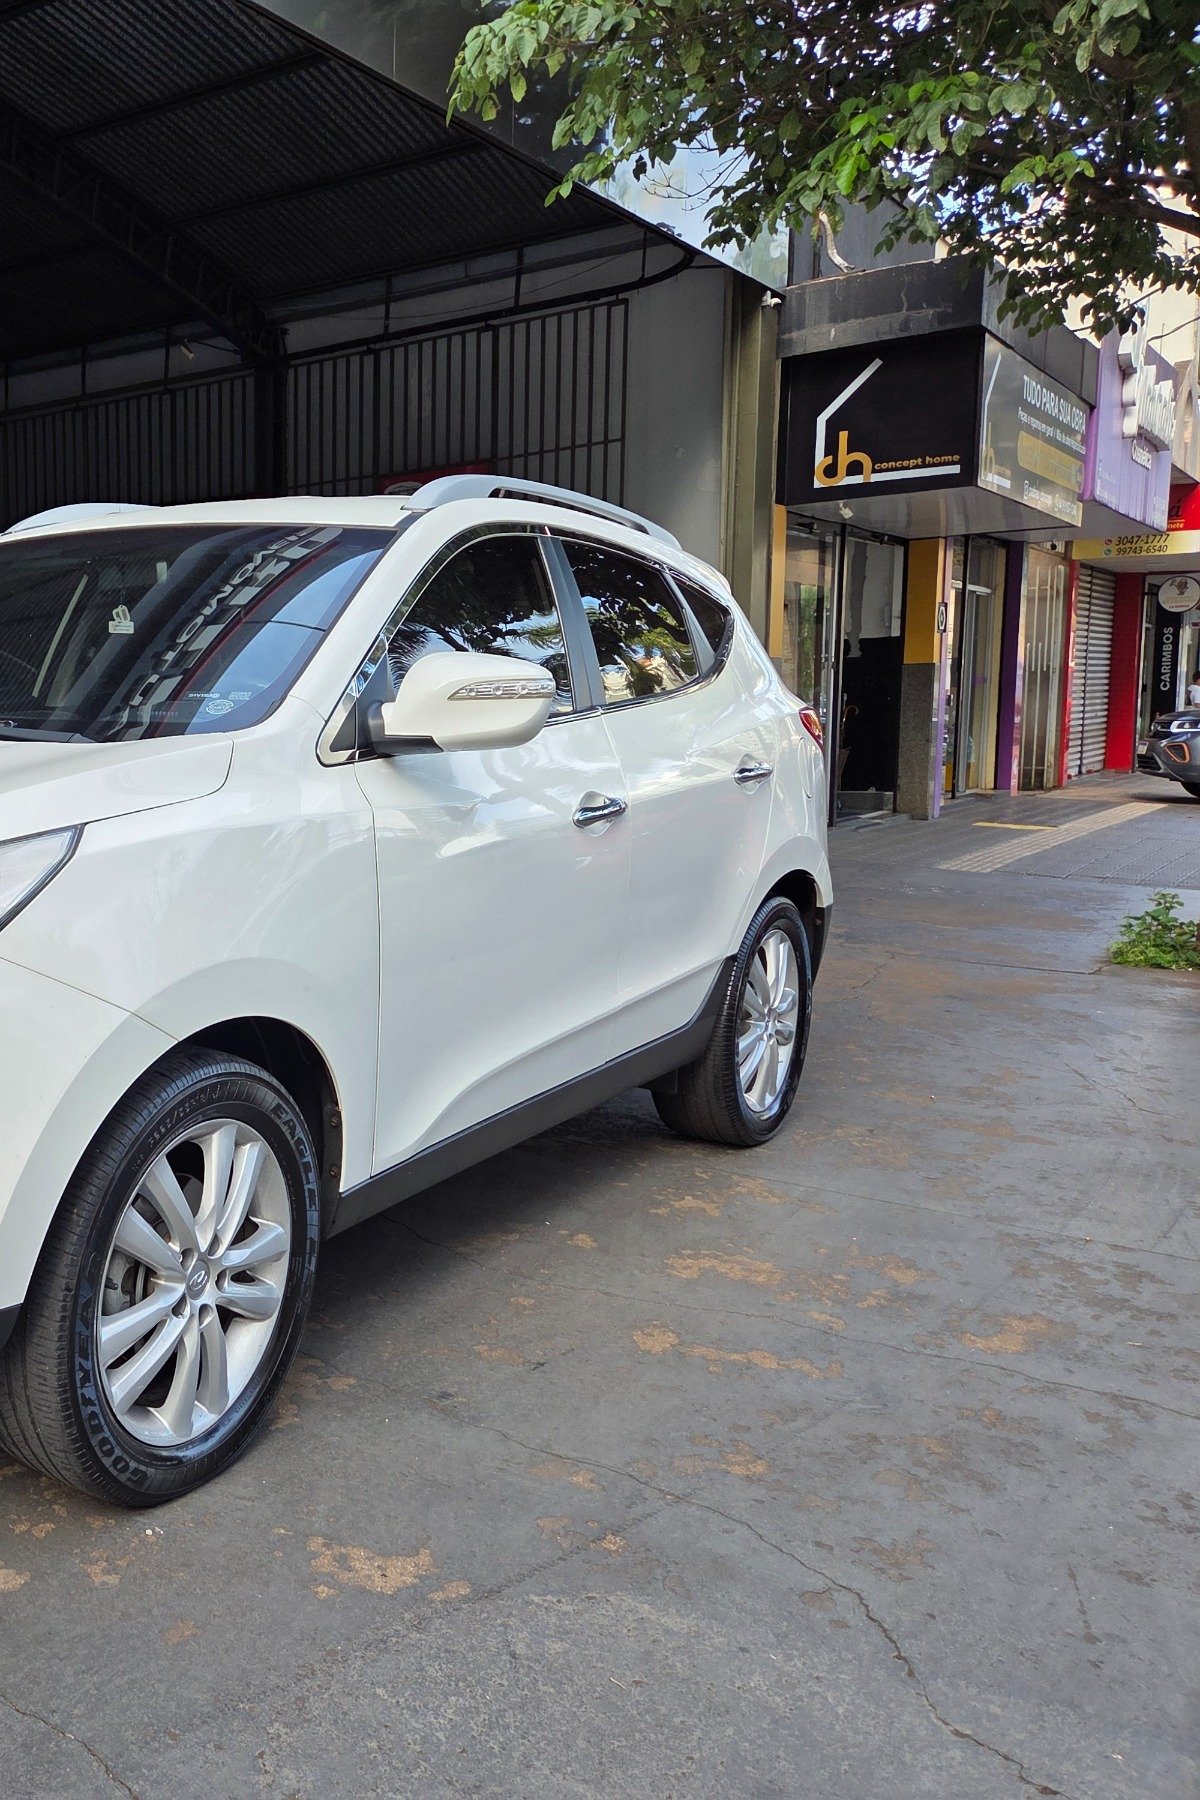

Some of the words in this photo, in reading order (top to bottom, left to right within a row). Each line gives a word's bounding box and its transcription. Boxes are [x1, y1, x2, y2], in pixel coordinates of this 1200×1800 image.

[1023, 374, 1041, 408] TUDO
[1041, 387, 1059, 418] PARA
[1059, 398, 1071, 426] SUA
[874, 456, 922, 470] concept
[925, 453, 961, 465] home
[1115, 533, 1170, 546] 3047-1777
[1115, 544, 1168, 556] 99743-6540
[1160, 626, 1174, 691] CARIMBOS
